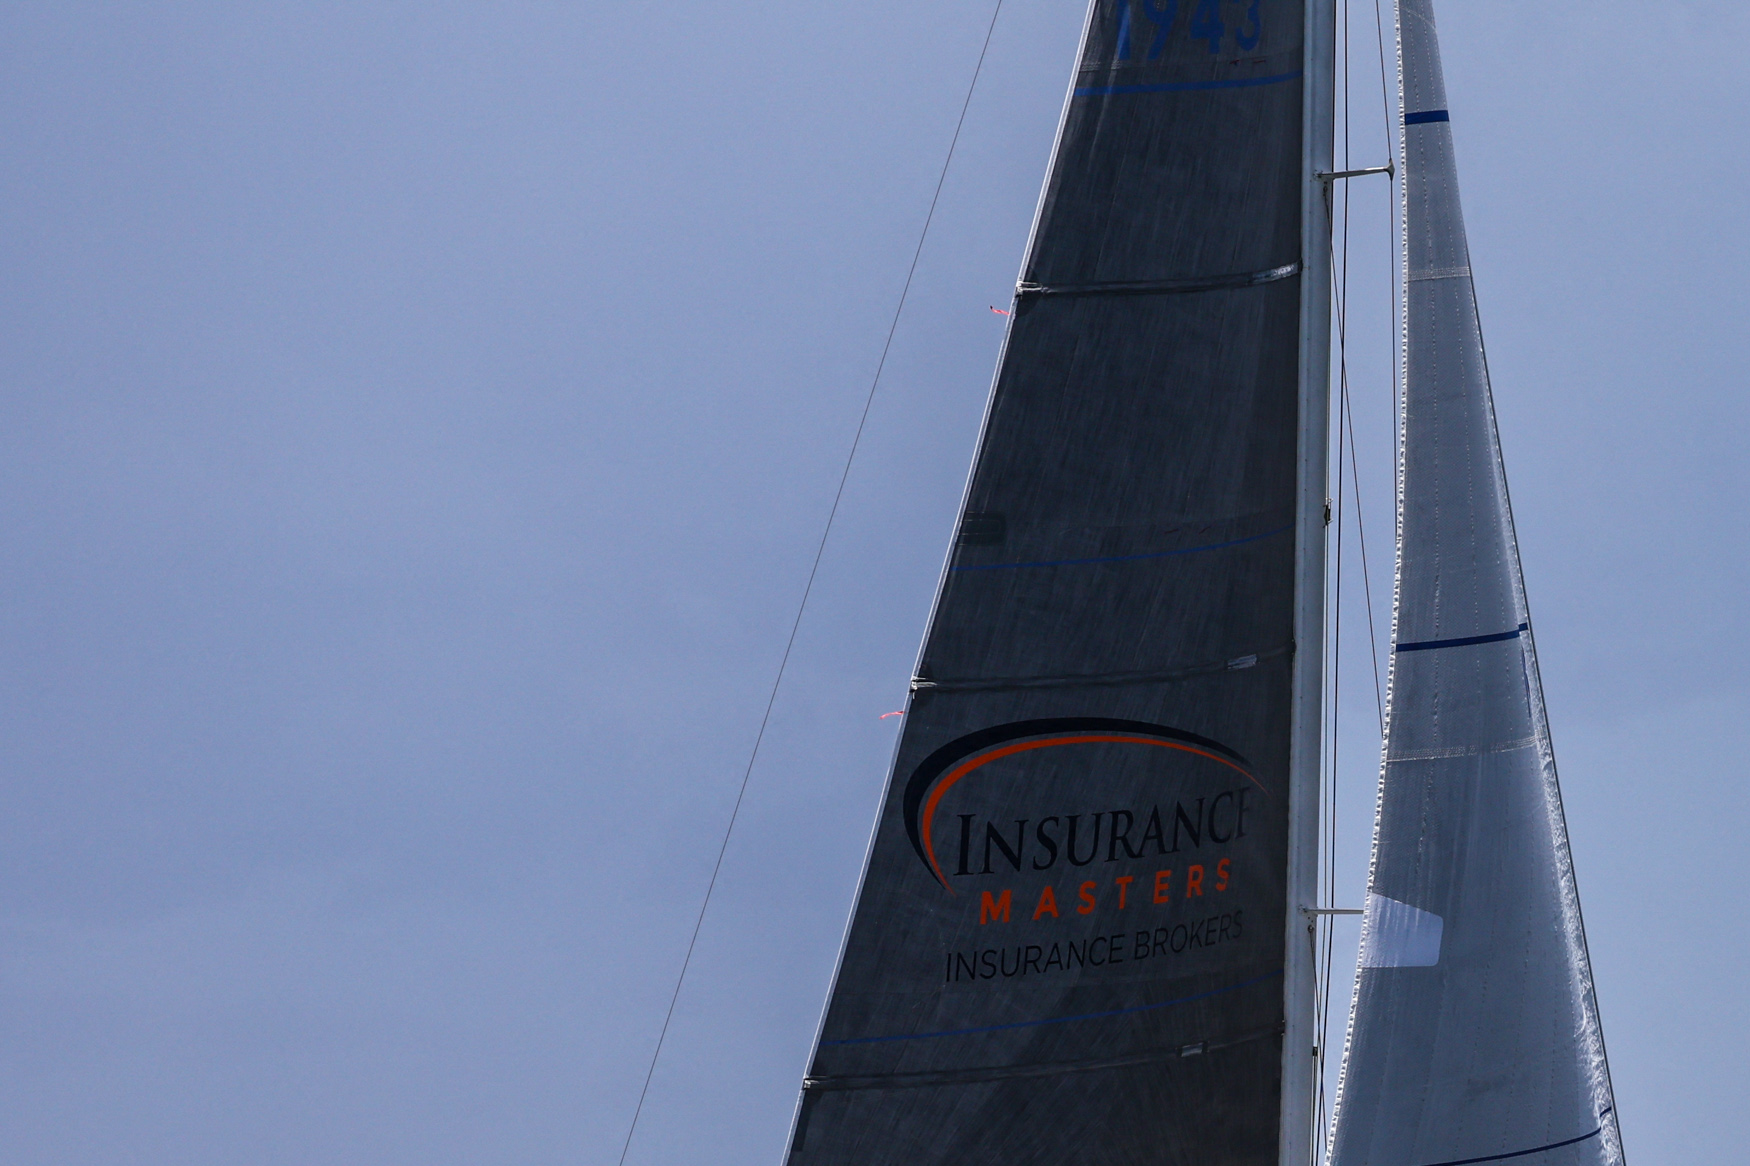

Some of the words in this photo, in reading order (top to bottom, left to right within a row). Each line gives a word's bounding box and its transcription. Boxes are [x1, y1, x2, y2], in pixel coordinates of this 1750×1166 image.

[979, 857, 1232, 925] MASTERS
[945, 934, 1126, 983] INSURANCE
[1133, 910, 1244, 961] BROKERS
